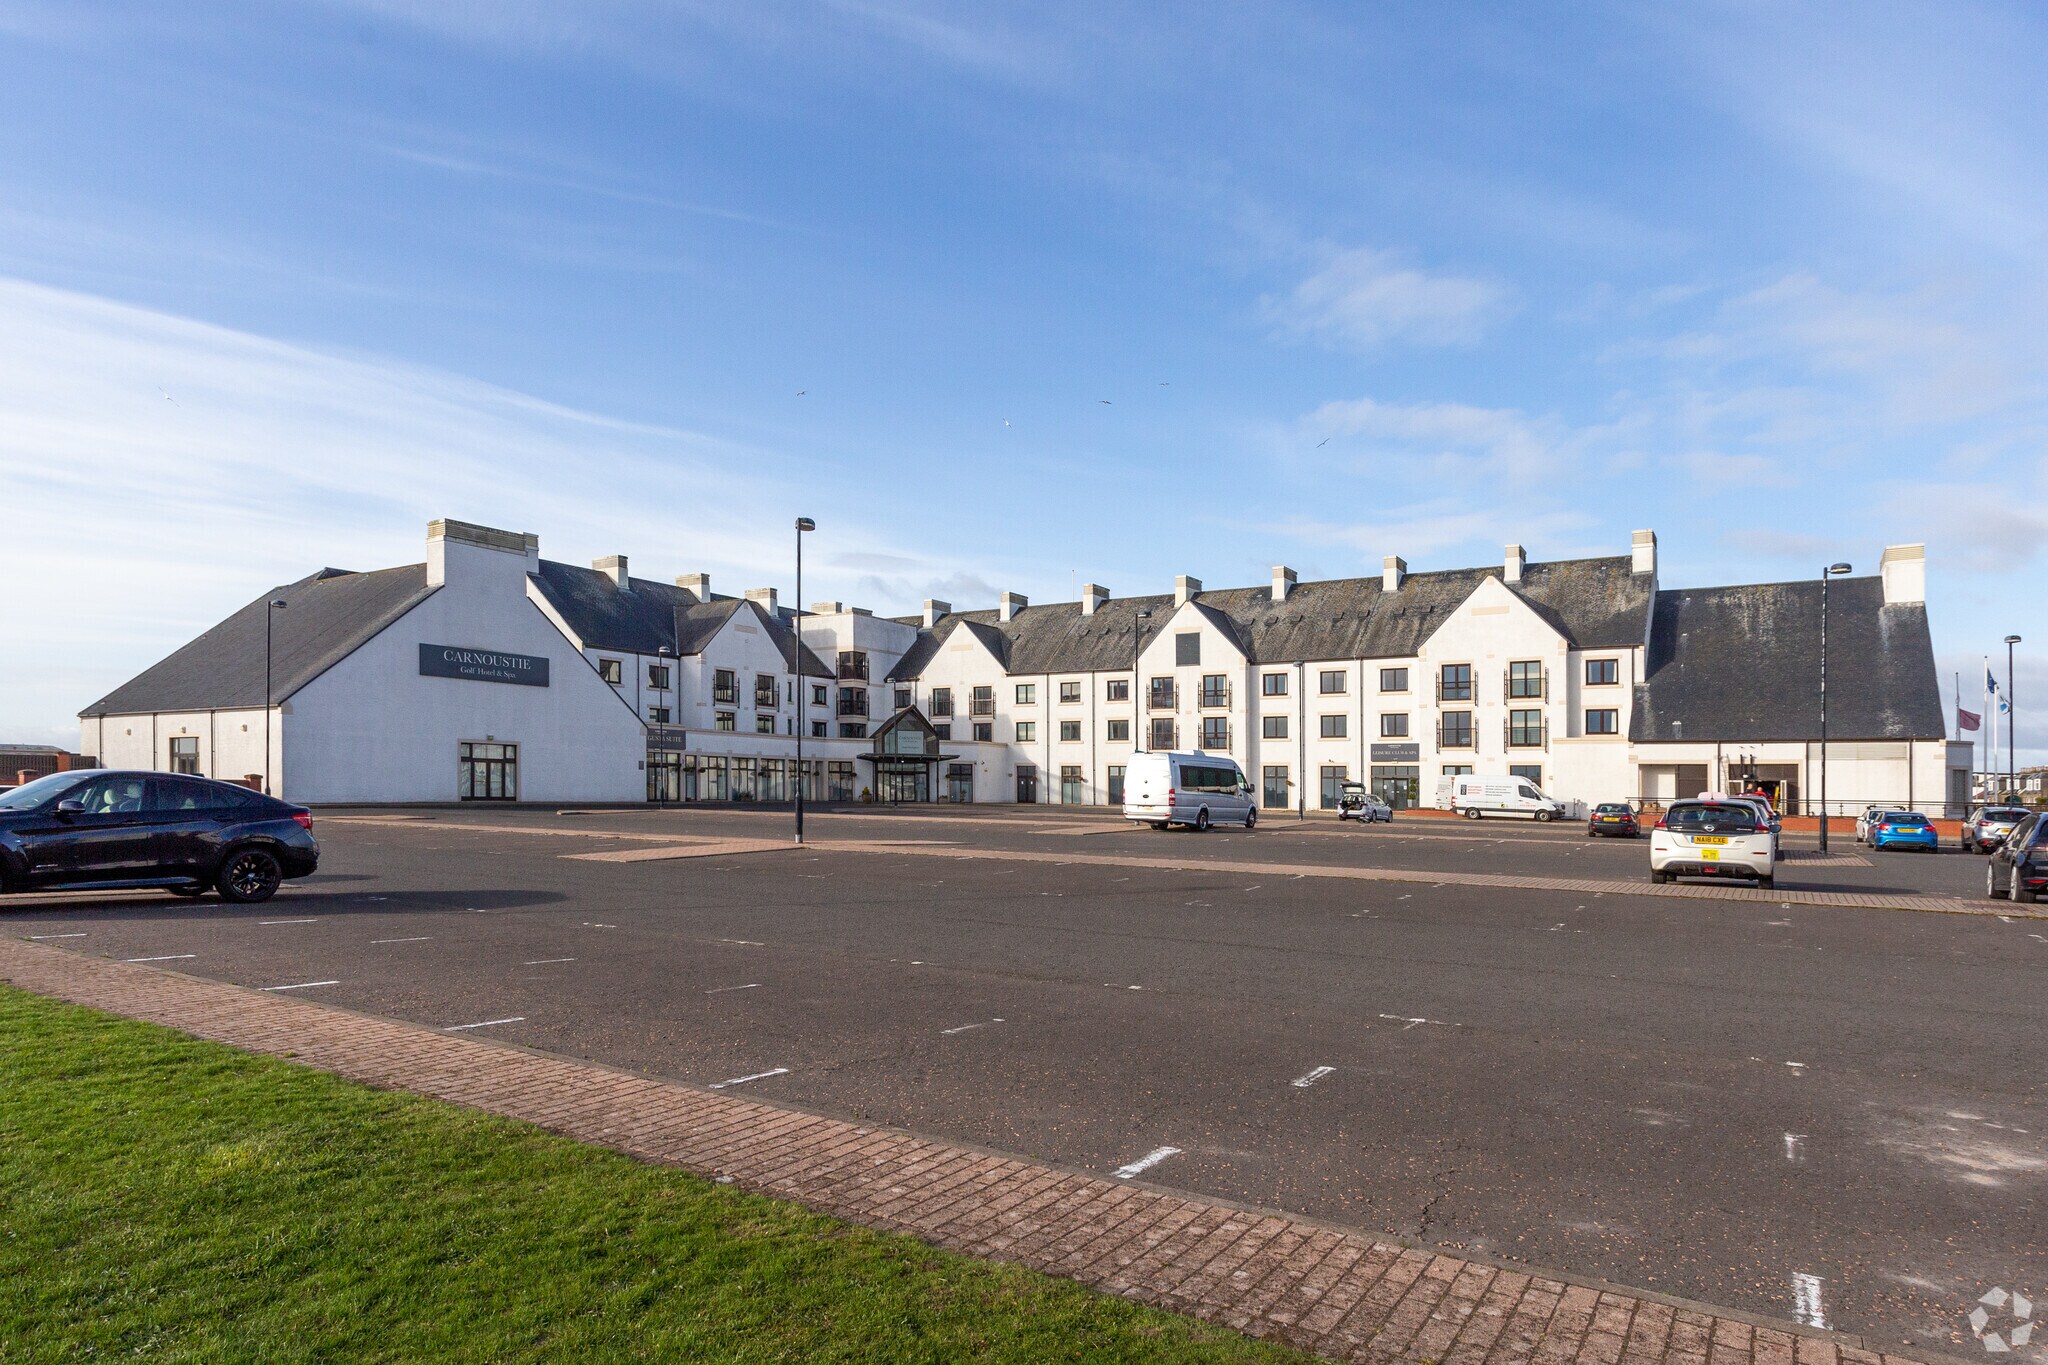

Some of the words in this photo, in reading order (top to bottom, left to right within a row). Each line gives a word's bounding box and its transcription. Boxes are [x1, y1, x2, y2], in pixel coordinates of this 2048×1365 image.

[443, 649, 531, 670] CARNOUSTIE
[460, 666, 475, 674] Golf
[478, 667, 496, 676] Hotel
[503, 670, 516, 679] Spa
